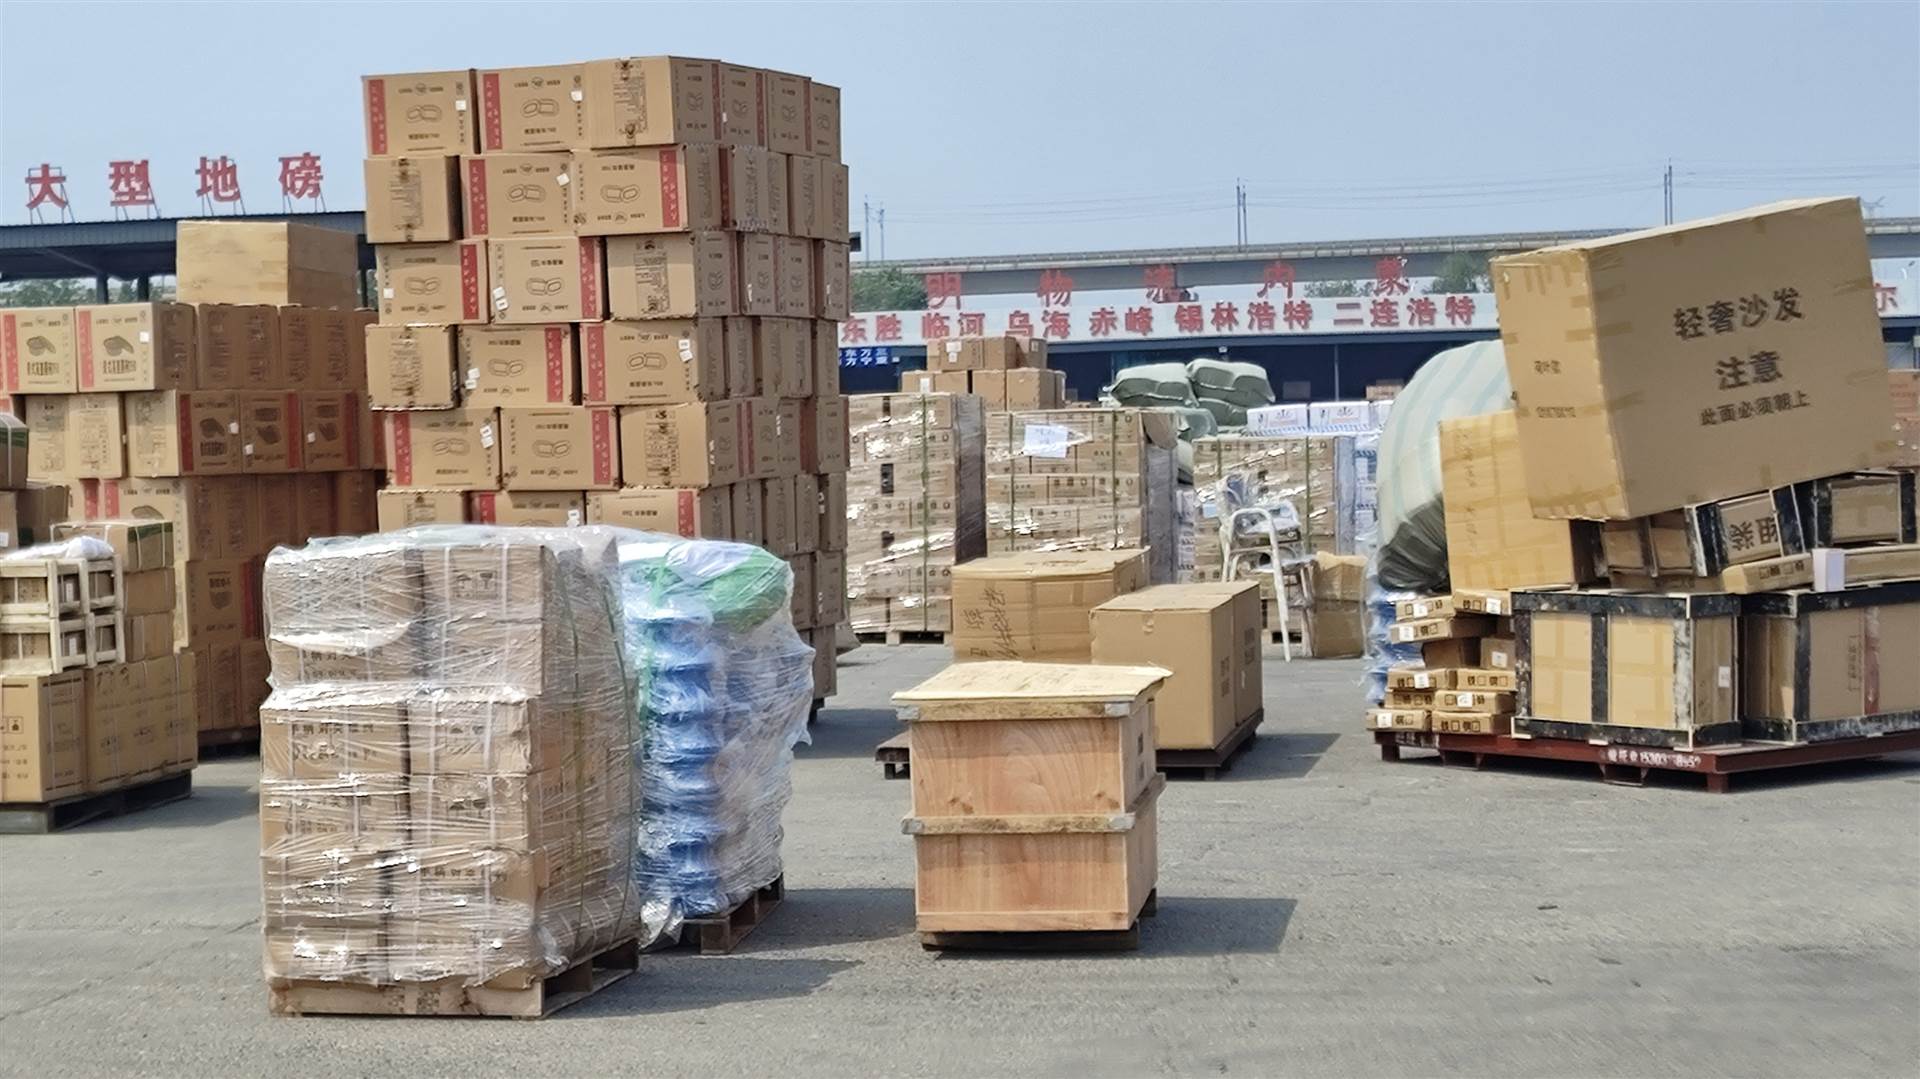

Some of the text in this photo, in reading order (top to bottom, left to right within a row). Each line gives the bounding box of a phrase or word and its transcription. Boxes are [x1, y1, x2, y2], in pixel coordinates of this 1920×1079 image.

[25, 152, 324, 209] 大型地磅
[841, 313, 902, 343] 东胜
[922, 312, 985, 338] 临河
[1005, 310, 1071, 339] 乌海
[1089, 305, 1153, 336] 赤峰
[1174, 301, 1313, 333] 锡林浩特
[1333, 297, 1476, 327] 二连浩特
[1674, 287, 1805, 341] 轻奢沙发
[1716, 350, 1783, 390] 注意
[1701, 390, 1810, 426] 此面必须朝上
